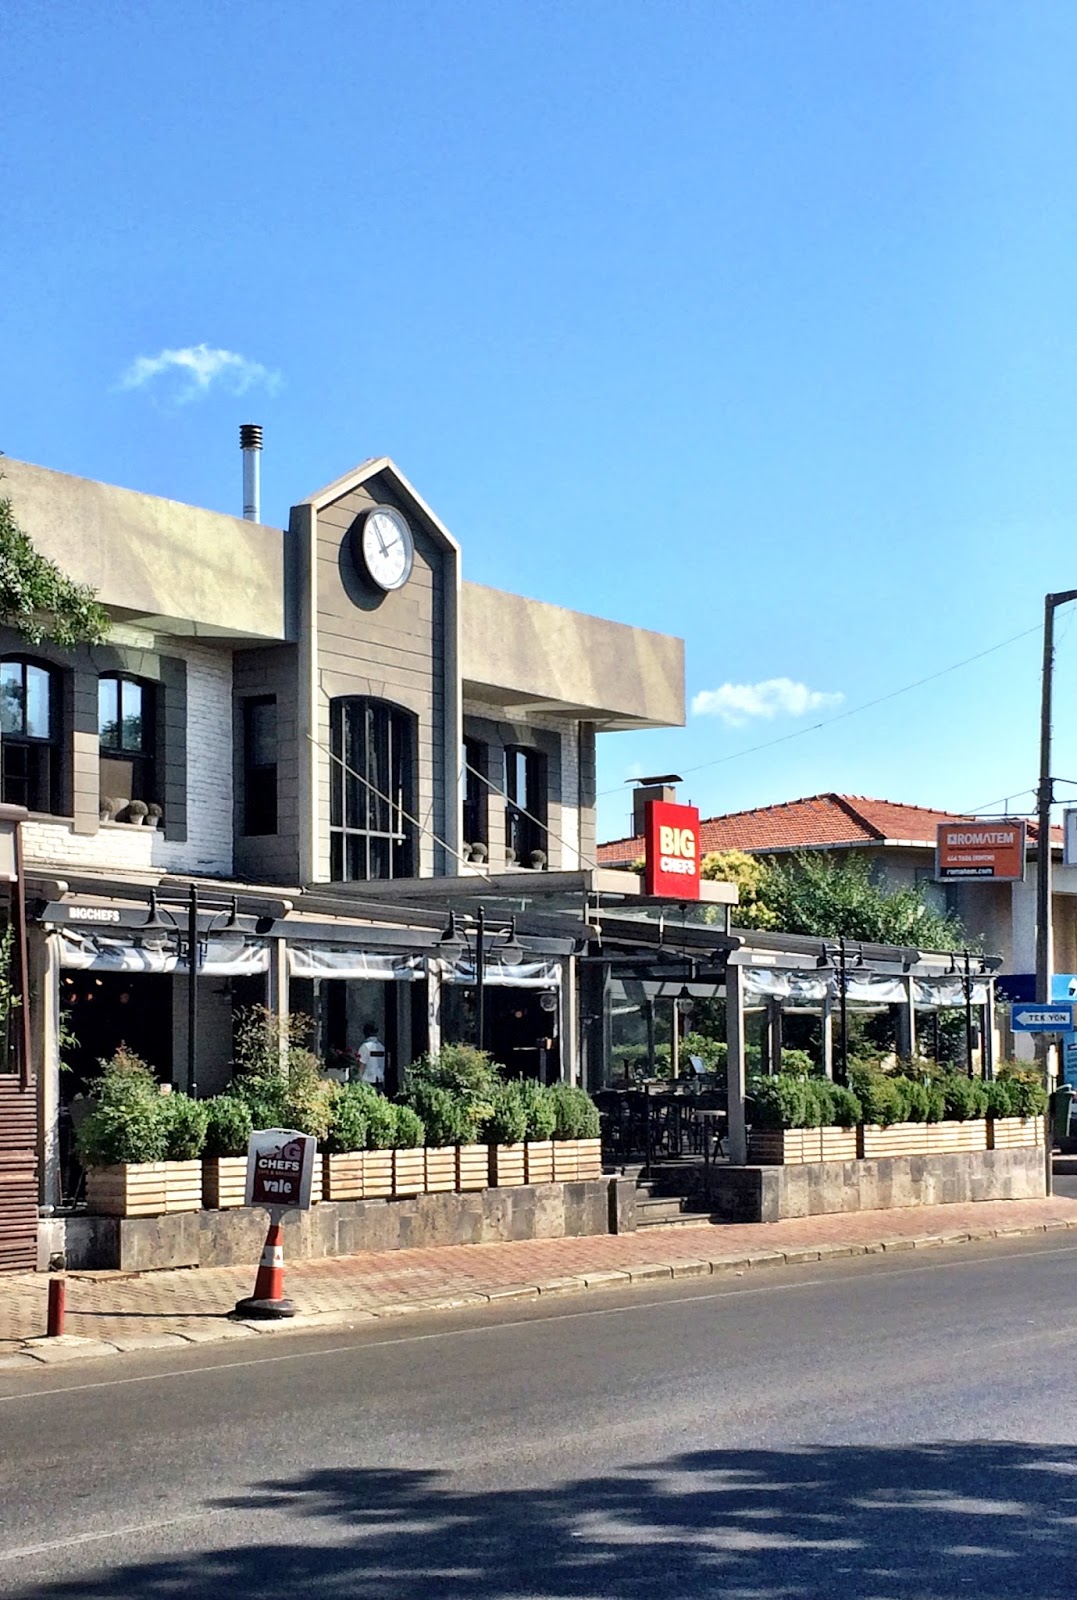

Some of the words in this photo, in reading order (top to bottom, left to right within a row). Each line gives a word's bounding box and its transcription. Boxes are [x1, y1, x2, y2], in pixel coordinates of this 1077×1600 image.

[660, 825, 696, 858] BIG
[958, 832, 1014, 845] ROMATEM
[660, 856, 696, 876] CHEFS
[69, 907, 120, 922] BIGCHEFS
[258, 1158, 300, 1172] CHEFS
[263, 1179, 292, 1194] vale
